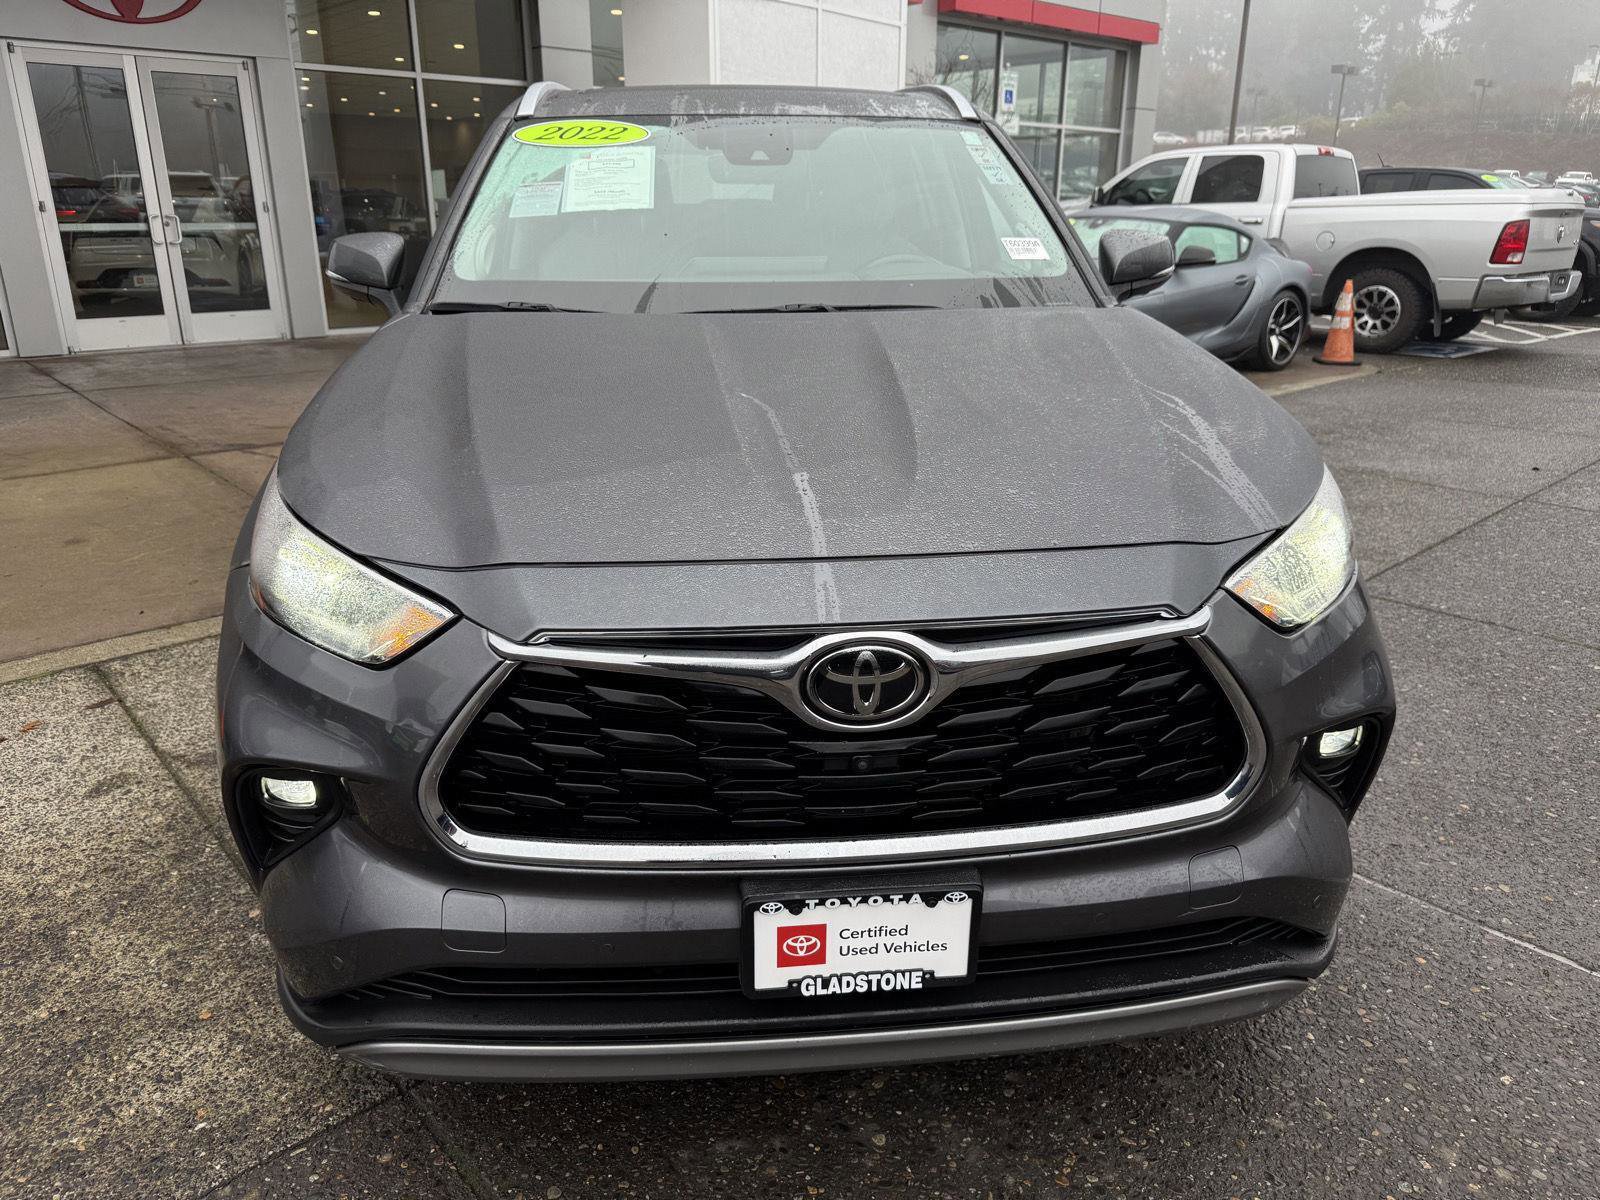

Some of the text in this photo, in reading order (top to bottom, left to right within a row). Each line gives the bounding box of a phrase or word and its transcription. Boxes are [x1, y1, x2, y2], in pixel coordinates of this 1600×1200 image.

[534, 126, 628, 140] 2022
[805, 893, 922, 910] TOYOTA
[839, 925, 909, 940] Certified
[839, 940, 948, 956] Used Vehicles
[800, 971, 923, 997] GLADSTONE
